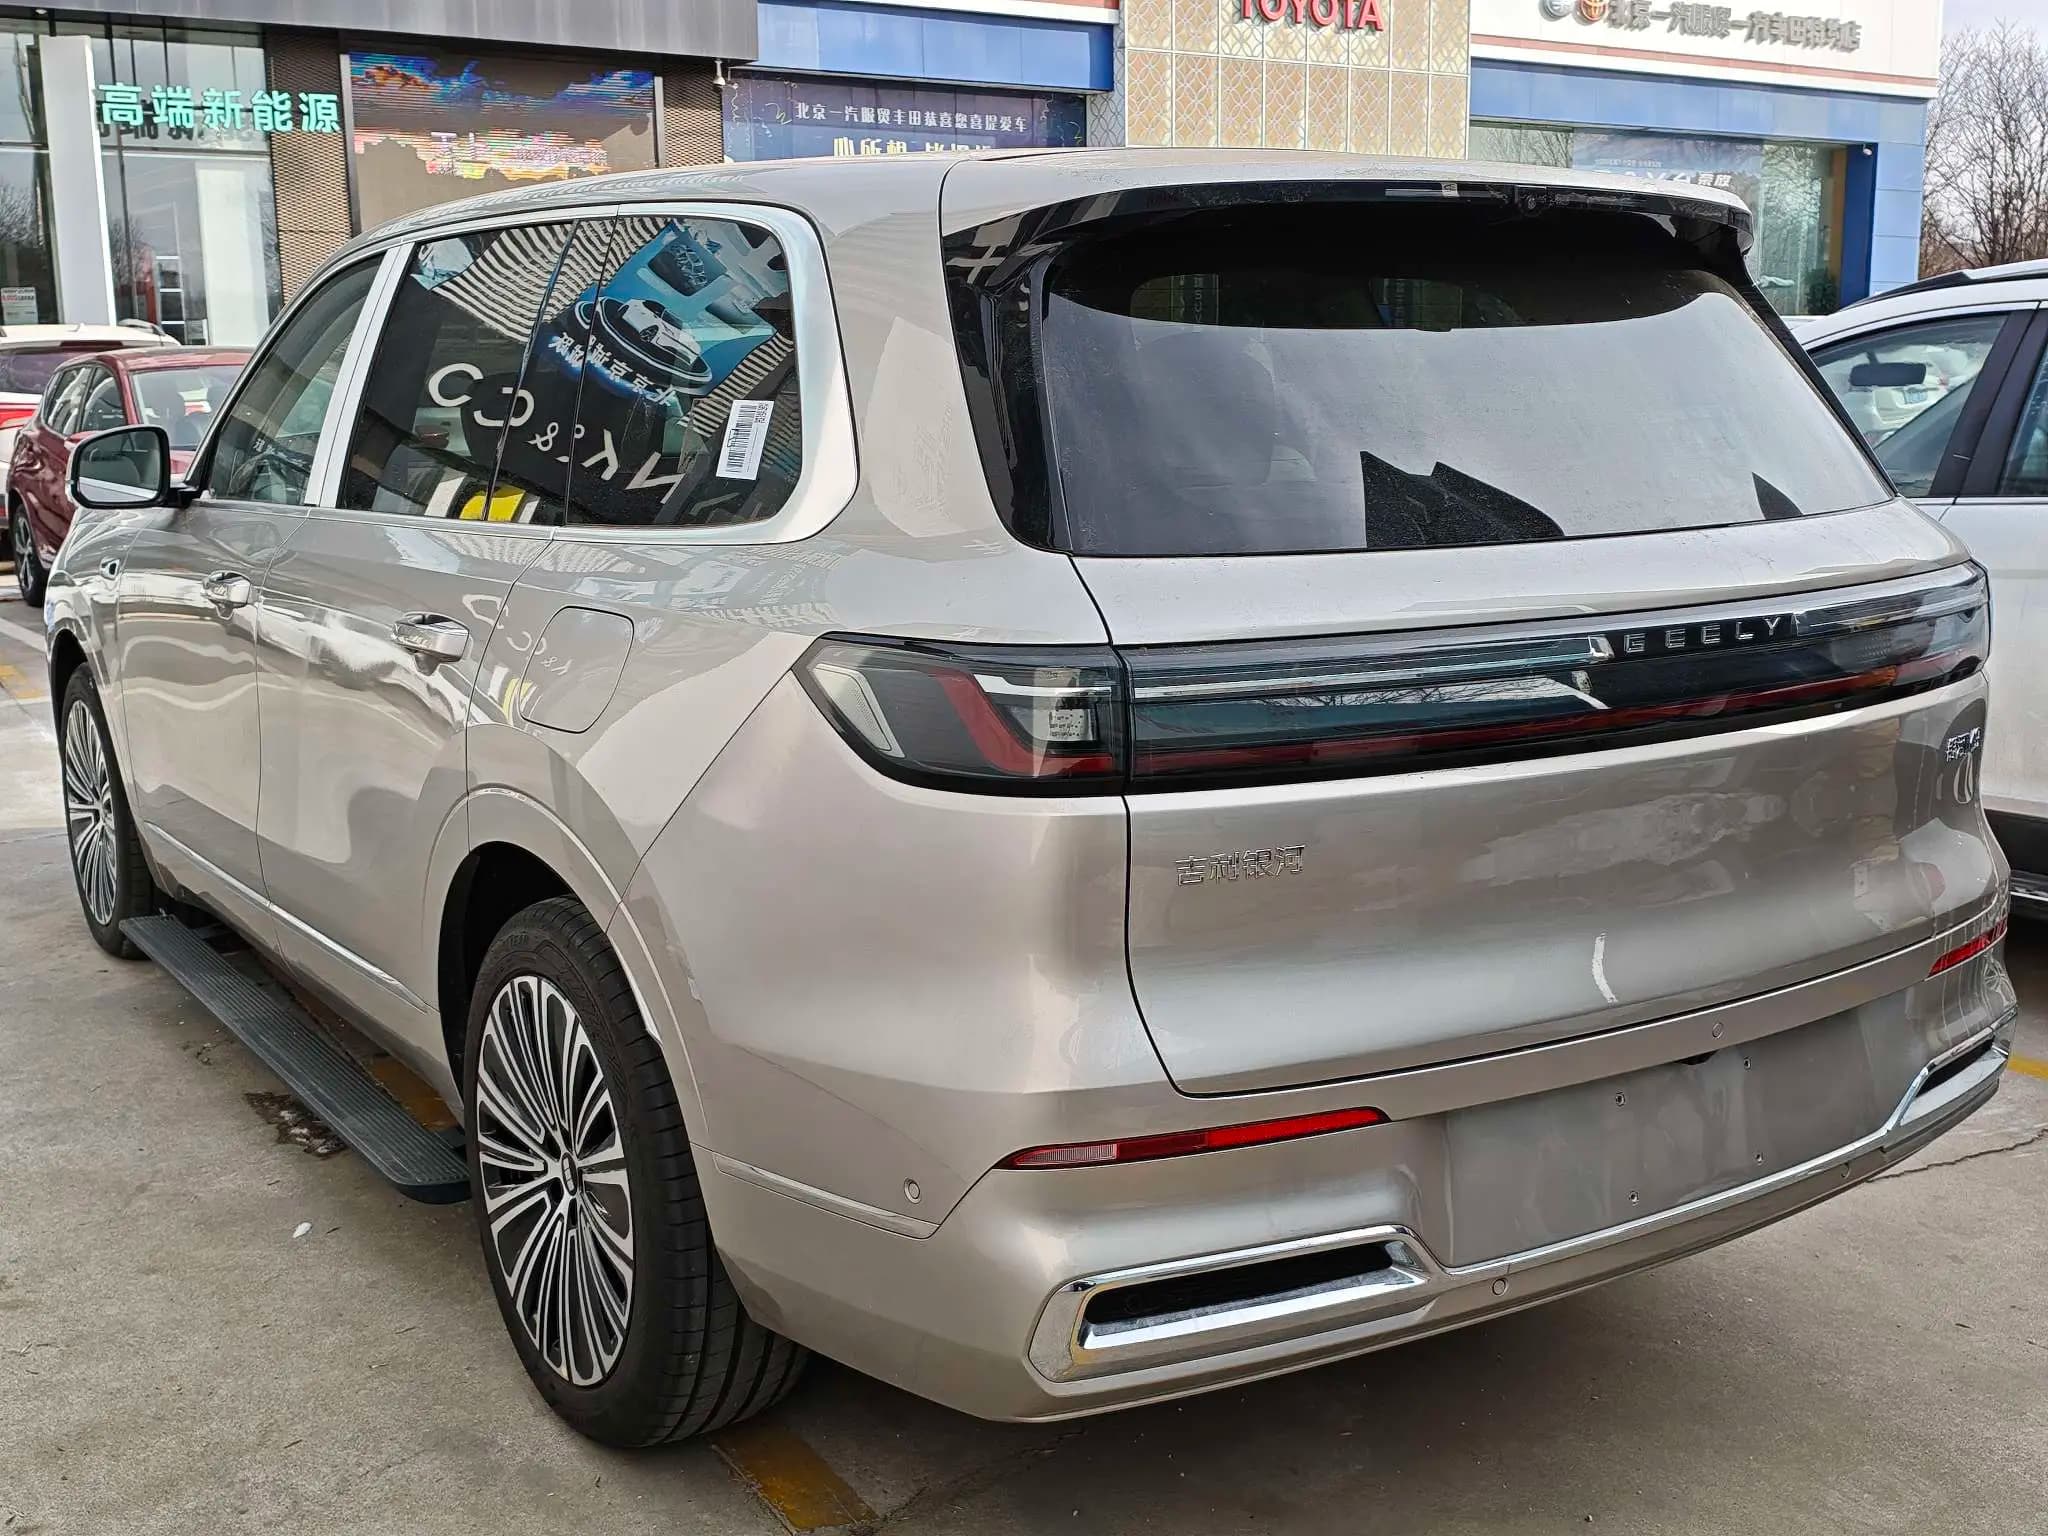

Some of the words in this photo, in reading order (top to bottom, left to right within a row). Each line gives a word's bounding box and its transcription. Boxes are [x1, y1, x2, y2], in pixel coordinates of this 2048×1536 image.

[1241, 0, 1385, 32] TOYOTA
[98, 82, 341, 133] 高端新能源
[1623, 616, 1782, 654] GEELY
[1174, 844, 1306, 886] 吉利银河
